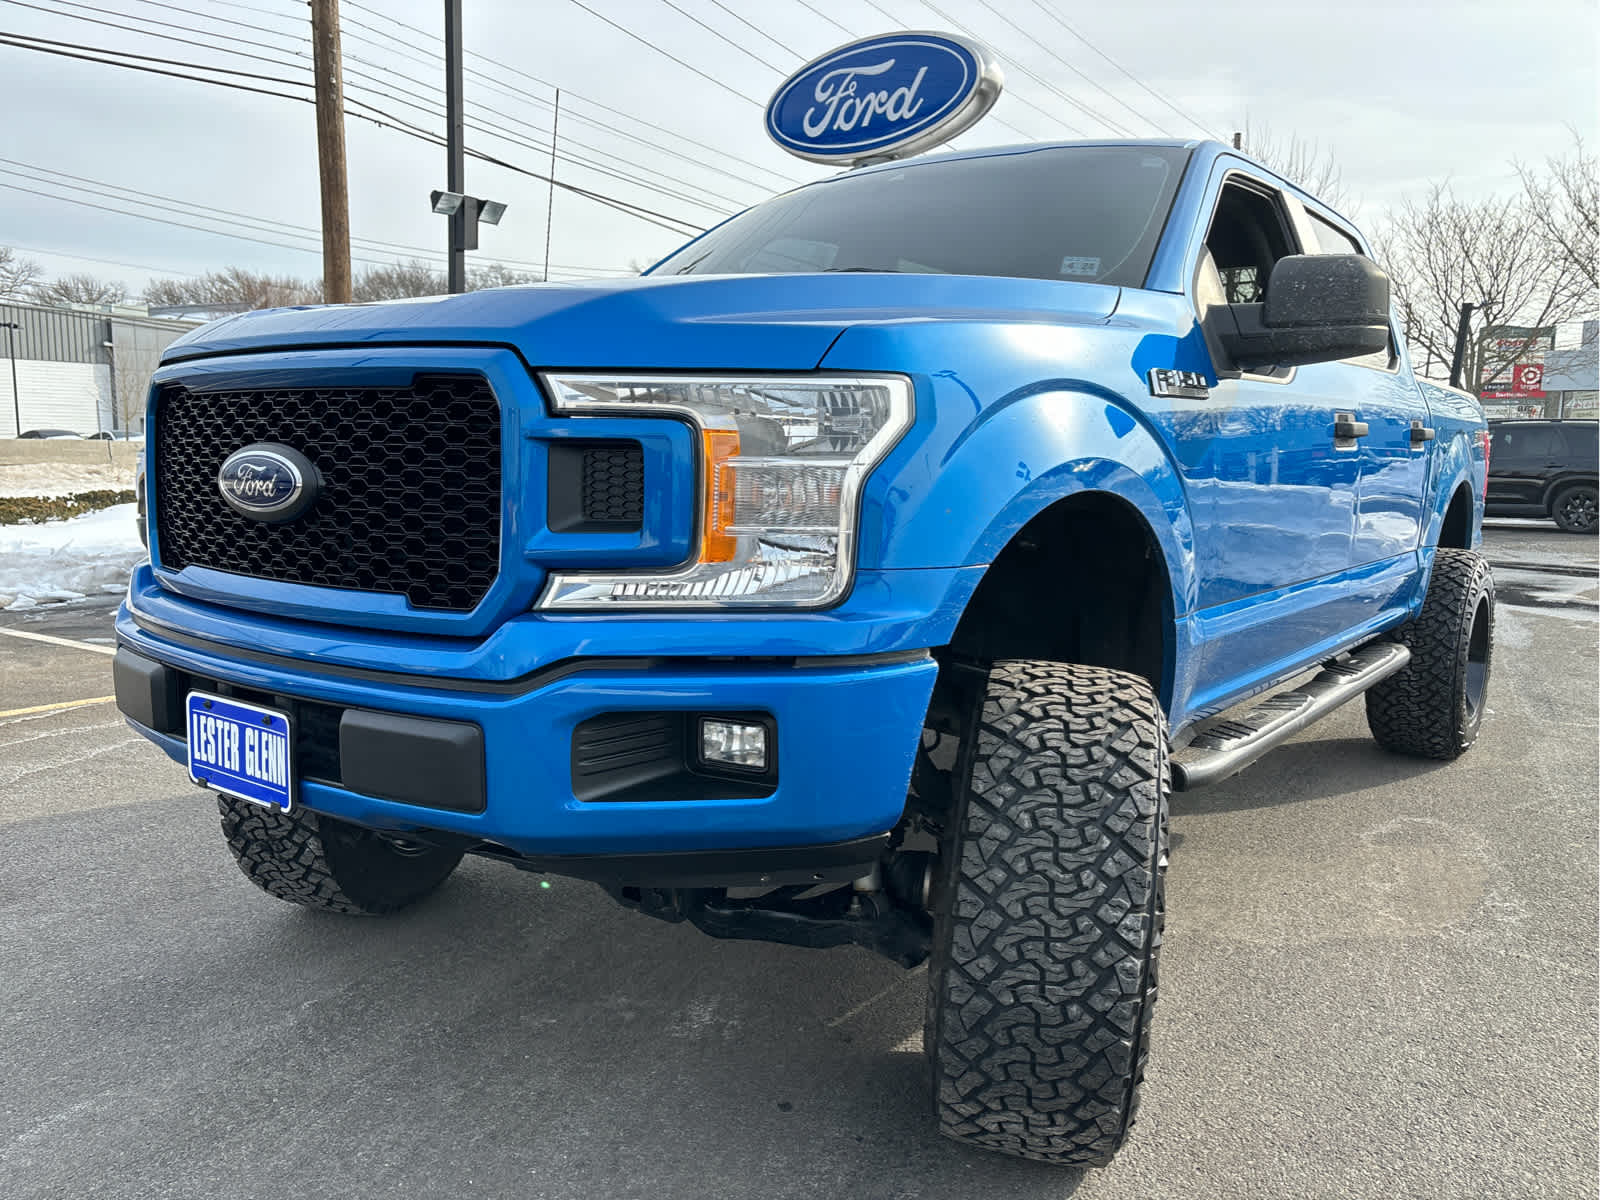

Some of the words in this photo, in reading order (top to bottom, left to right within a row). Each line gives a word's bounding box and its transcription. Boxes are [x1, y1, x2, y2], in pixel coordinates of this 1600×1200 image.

[803, 58, 928, 138] Ford
[233, 463, 277, 498] Ford
[192, 713, 240, 772] LESTER
[245, 727, 287, 788] GLENN
